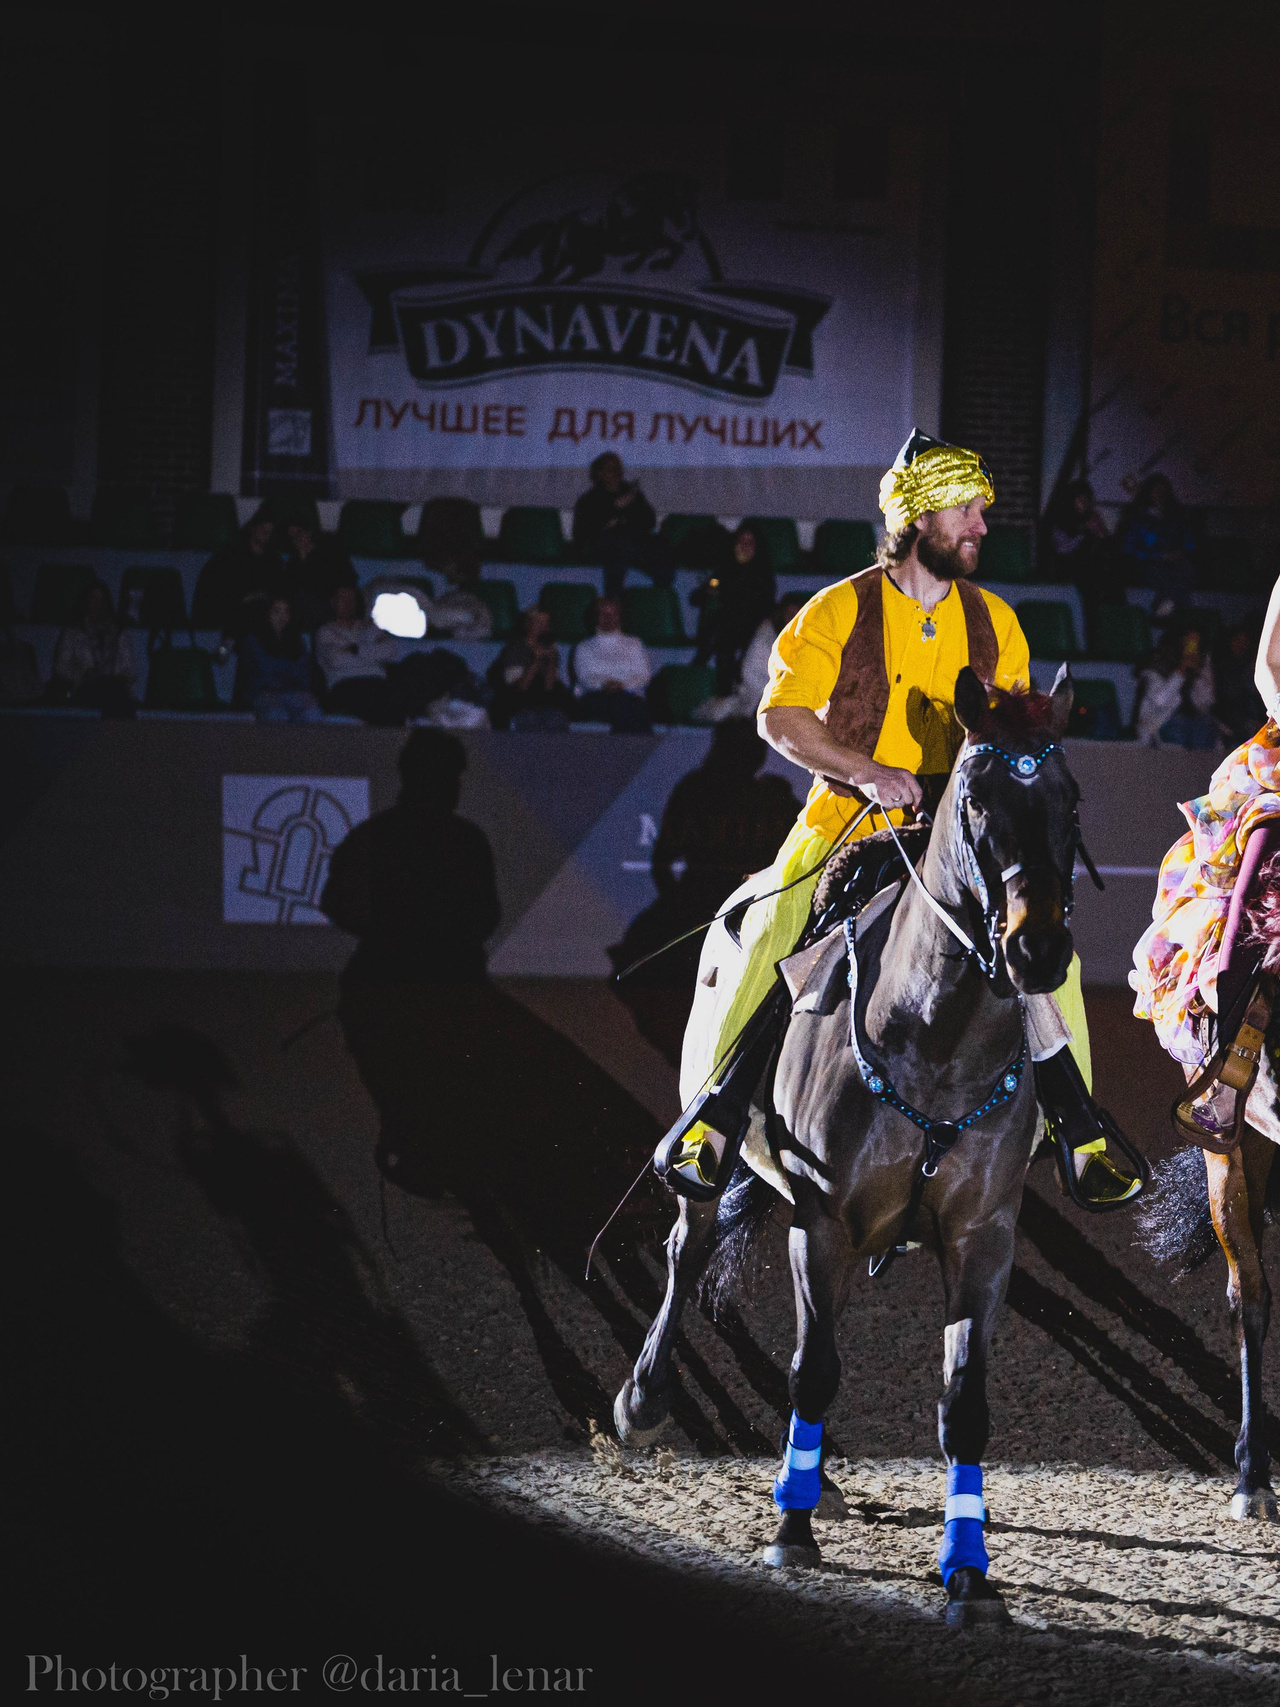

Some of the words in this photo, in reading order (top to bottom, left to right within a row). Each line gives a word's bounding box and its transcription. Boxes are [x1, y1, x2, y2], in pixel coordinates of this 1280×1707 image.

[418, 301, 766, 388] DYNAVENA
[1158, 295, 1251, 347] Вся
[355, 399, 526, 436] ЛУЧШЕЕ
[548, 406, 634, 444] ДЛЯ
[648, 412, 824, 449] ЛУЧШИХ
